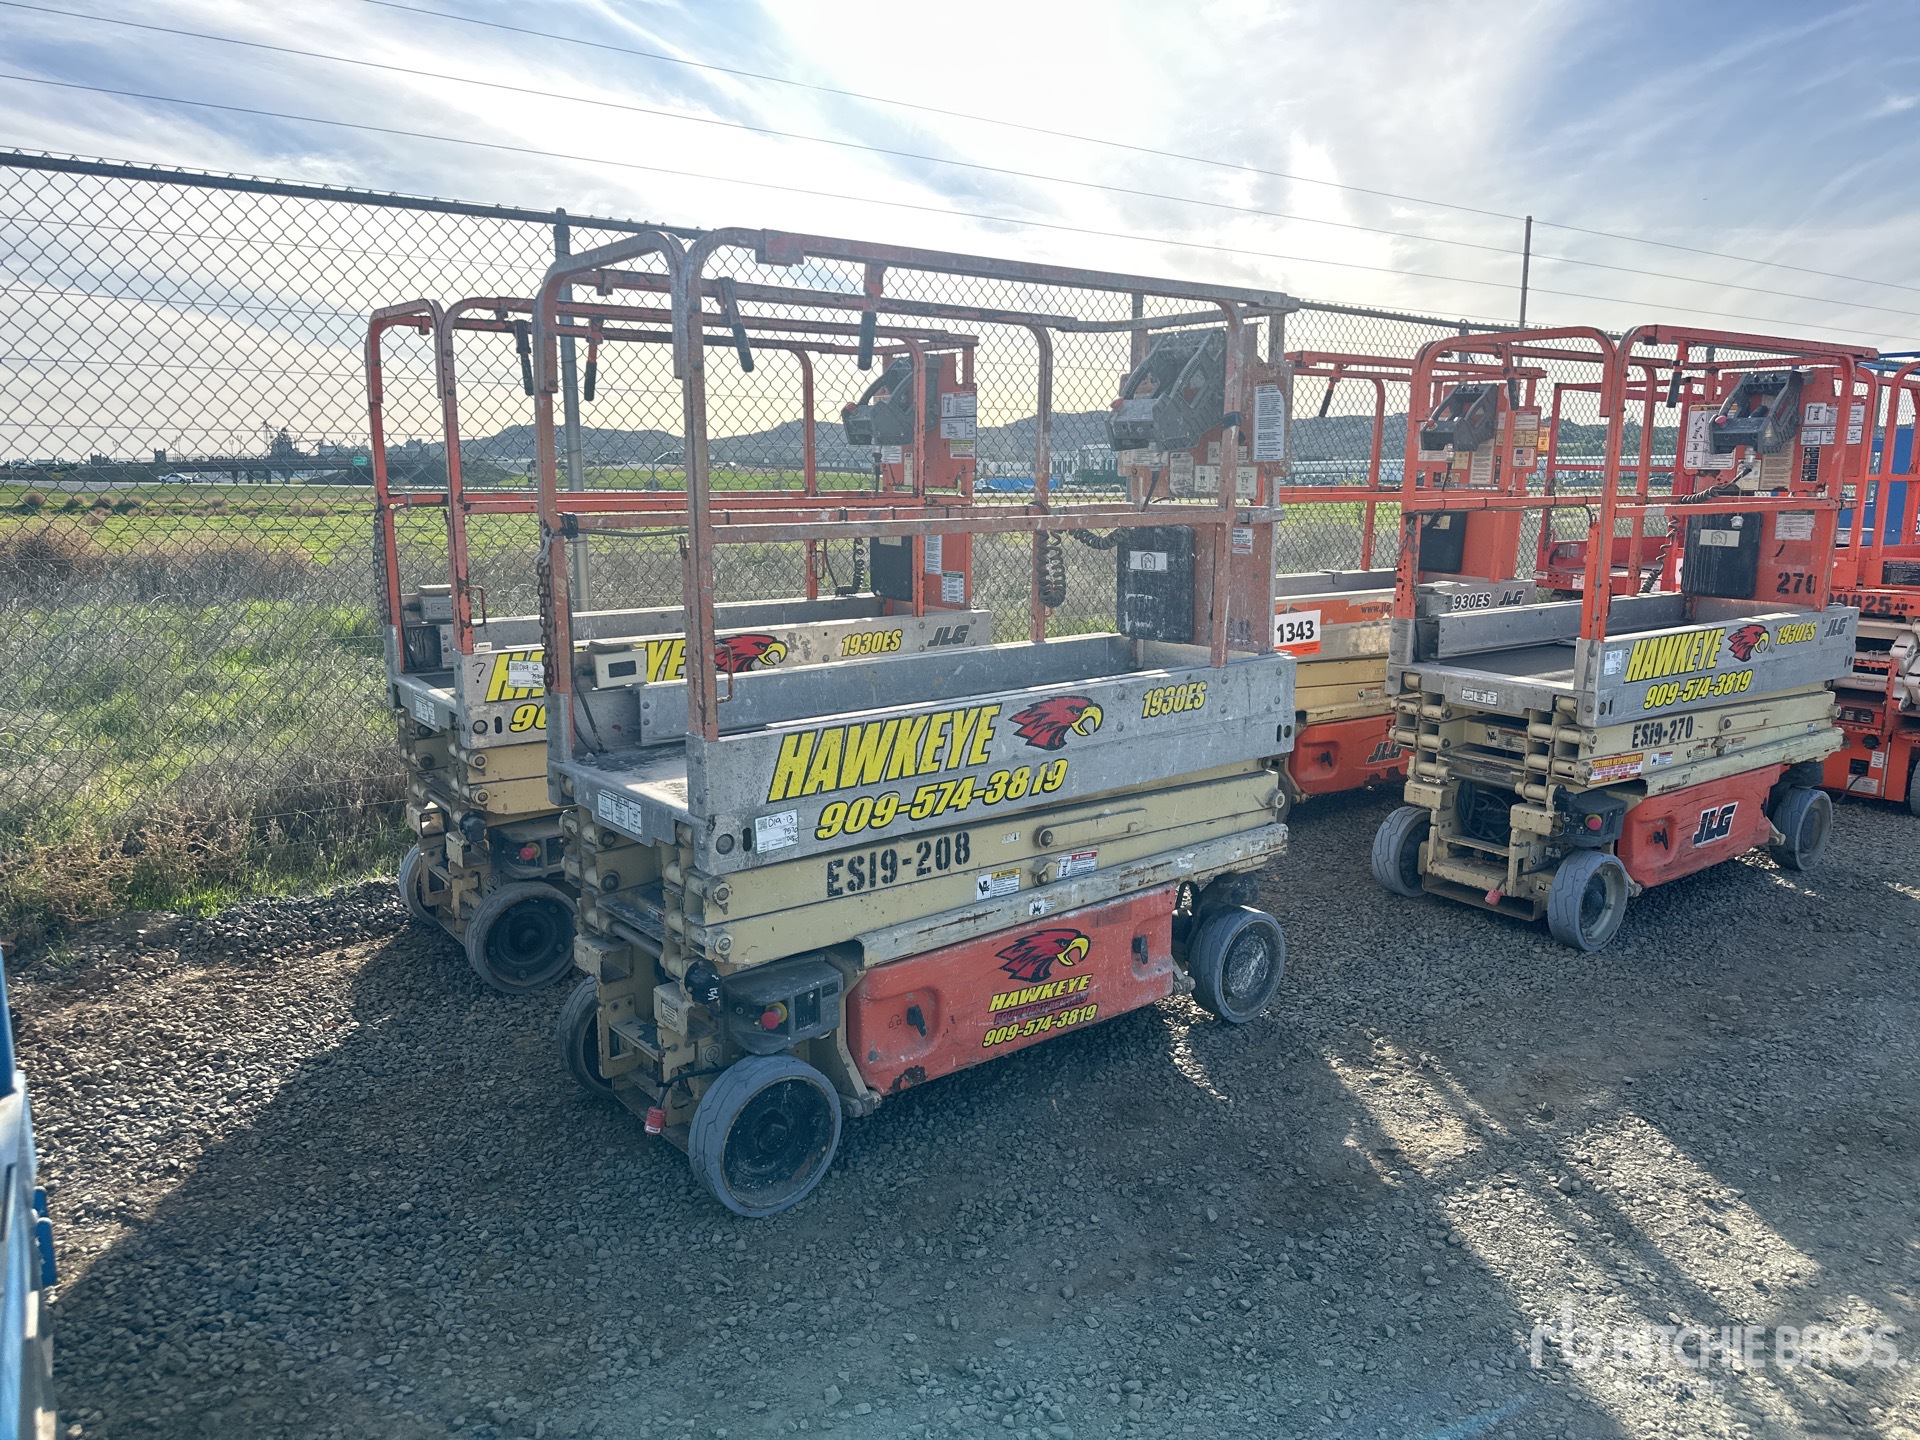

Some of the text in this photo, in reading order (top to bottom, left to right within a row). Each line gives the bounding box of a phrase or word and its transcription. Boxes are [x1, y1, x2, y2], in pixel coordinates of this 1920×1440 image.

[1451, 592, 1491, 611] 930ES
[841, 624, 970, 657] 1930ES JLG
[1277, 620, 1315, 643] 1343
[1623, 627, 1726, 684] HAWKEYE
[1775, 621, 1817, 646] 1930ES
[1825, 616, 1849, 638] JLG
[1643, 669, 1753, 710] 909-574-3819
[766, 681, 1208, 803] HAWKEYE 1930ES
[1632, 716, 1693, 748] ES19-270
[814, 759, 1069, 841] 909-574-3819
[1692, 802, 1739, 847] JLG
[827, 832, 971, 898] ES19-208
[987, 973, 1094, 1013] HAWKEYE
[982, 1004, 1099, 1048] 909-574-3819
